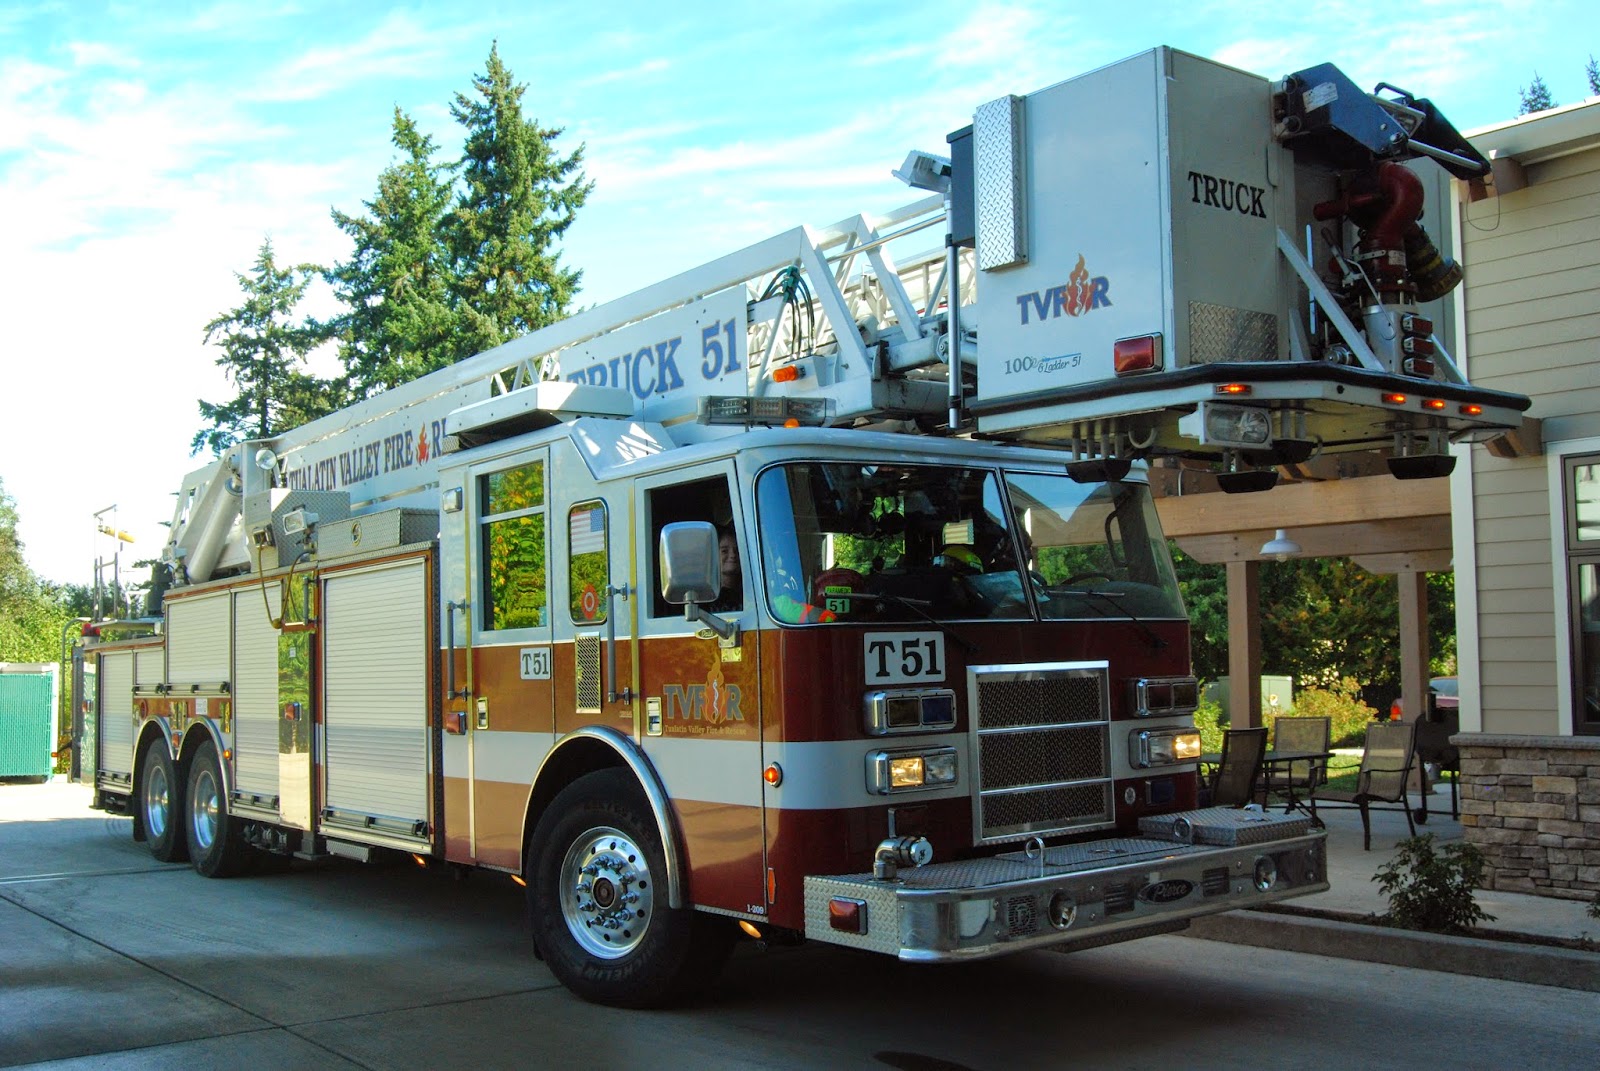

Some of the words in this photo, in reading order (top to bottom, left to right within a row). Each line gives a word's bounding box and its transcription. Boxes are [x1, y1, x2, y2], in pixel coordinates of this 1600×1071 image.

[1188, 171, 1267, 218] TRUCK
[701, 317, 742, 380] 51
[288, 456, 337, 491] TUALATIN
[339, 440, 381, 486] VALLEY
[384, 430, 413, 473] FIRE
[829, 600, 845, 612] 51
[522, 652, 549, 675] T51
[867, 638, 942, 677] T51
[665, 724, 687, 733] Tualatin
[688, 725, 706, 735] Valley
[706, 726, 718, 735] Fire
[1153, 882, 1188, 901] Pierce
